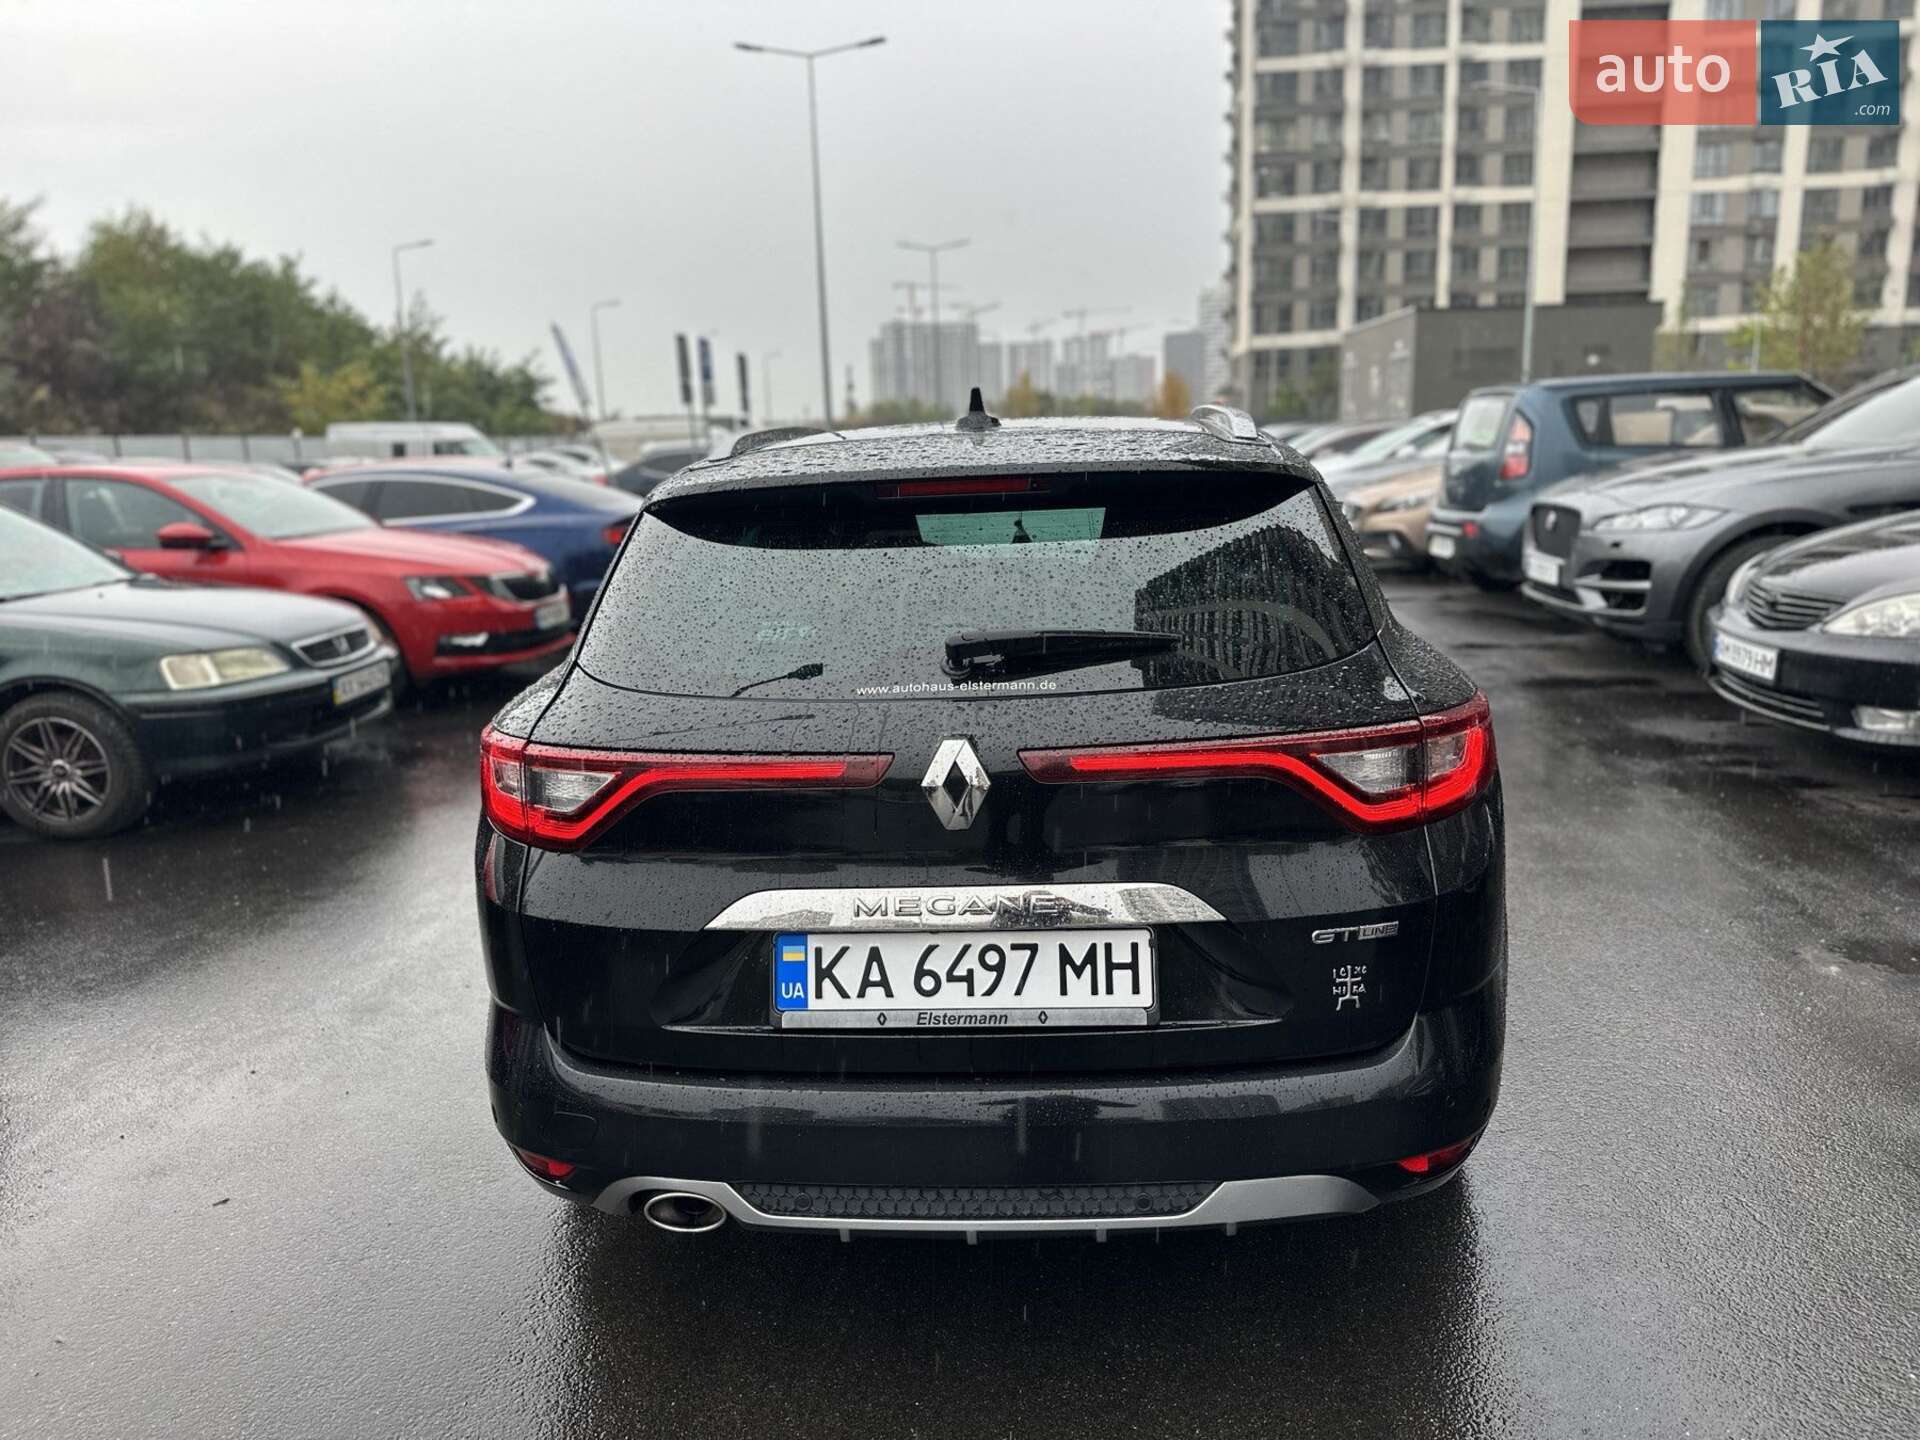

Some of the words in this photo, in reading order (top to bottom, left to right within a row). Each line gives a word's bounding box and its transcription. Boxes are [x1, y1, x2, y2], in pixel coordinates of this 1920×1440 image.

[856, 679, 1057, 695] www.autohaus-elstermann.de
[852, 893, 1060, 918] MEGANE
[815, 945, 894, 1000] KA
[913, 943, 1038, 998] 6497
[1058, 941, 1140, 996] MH
[781, 983, 804, 998] UA
[916, 1011, 1008, 1026] Elstermann
